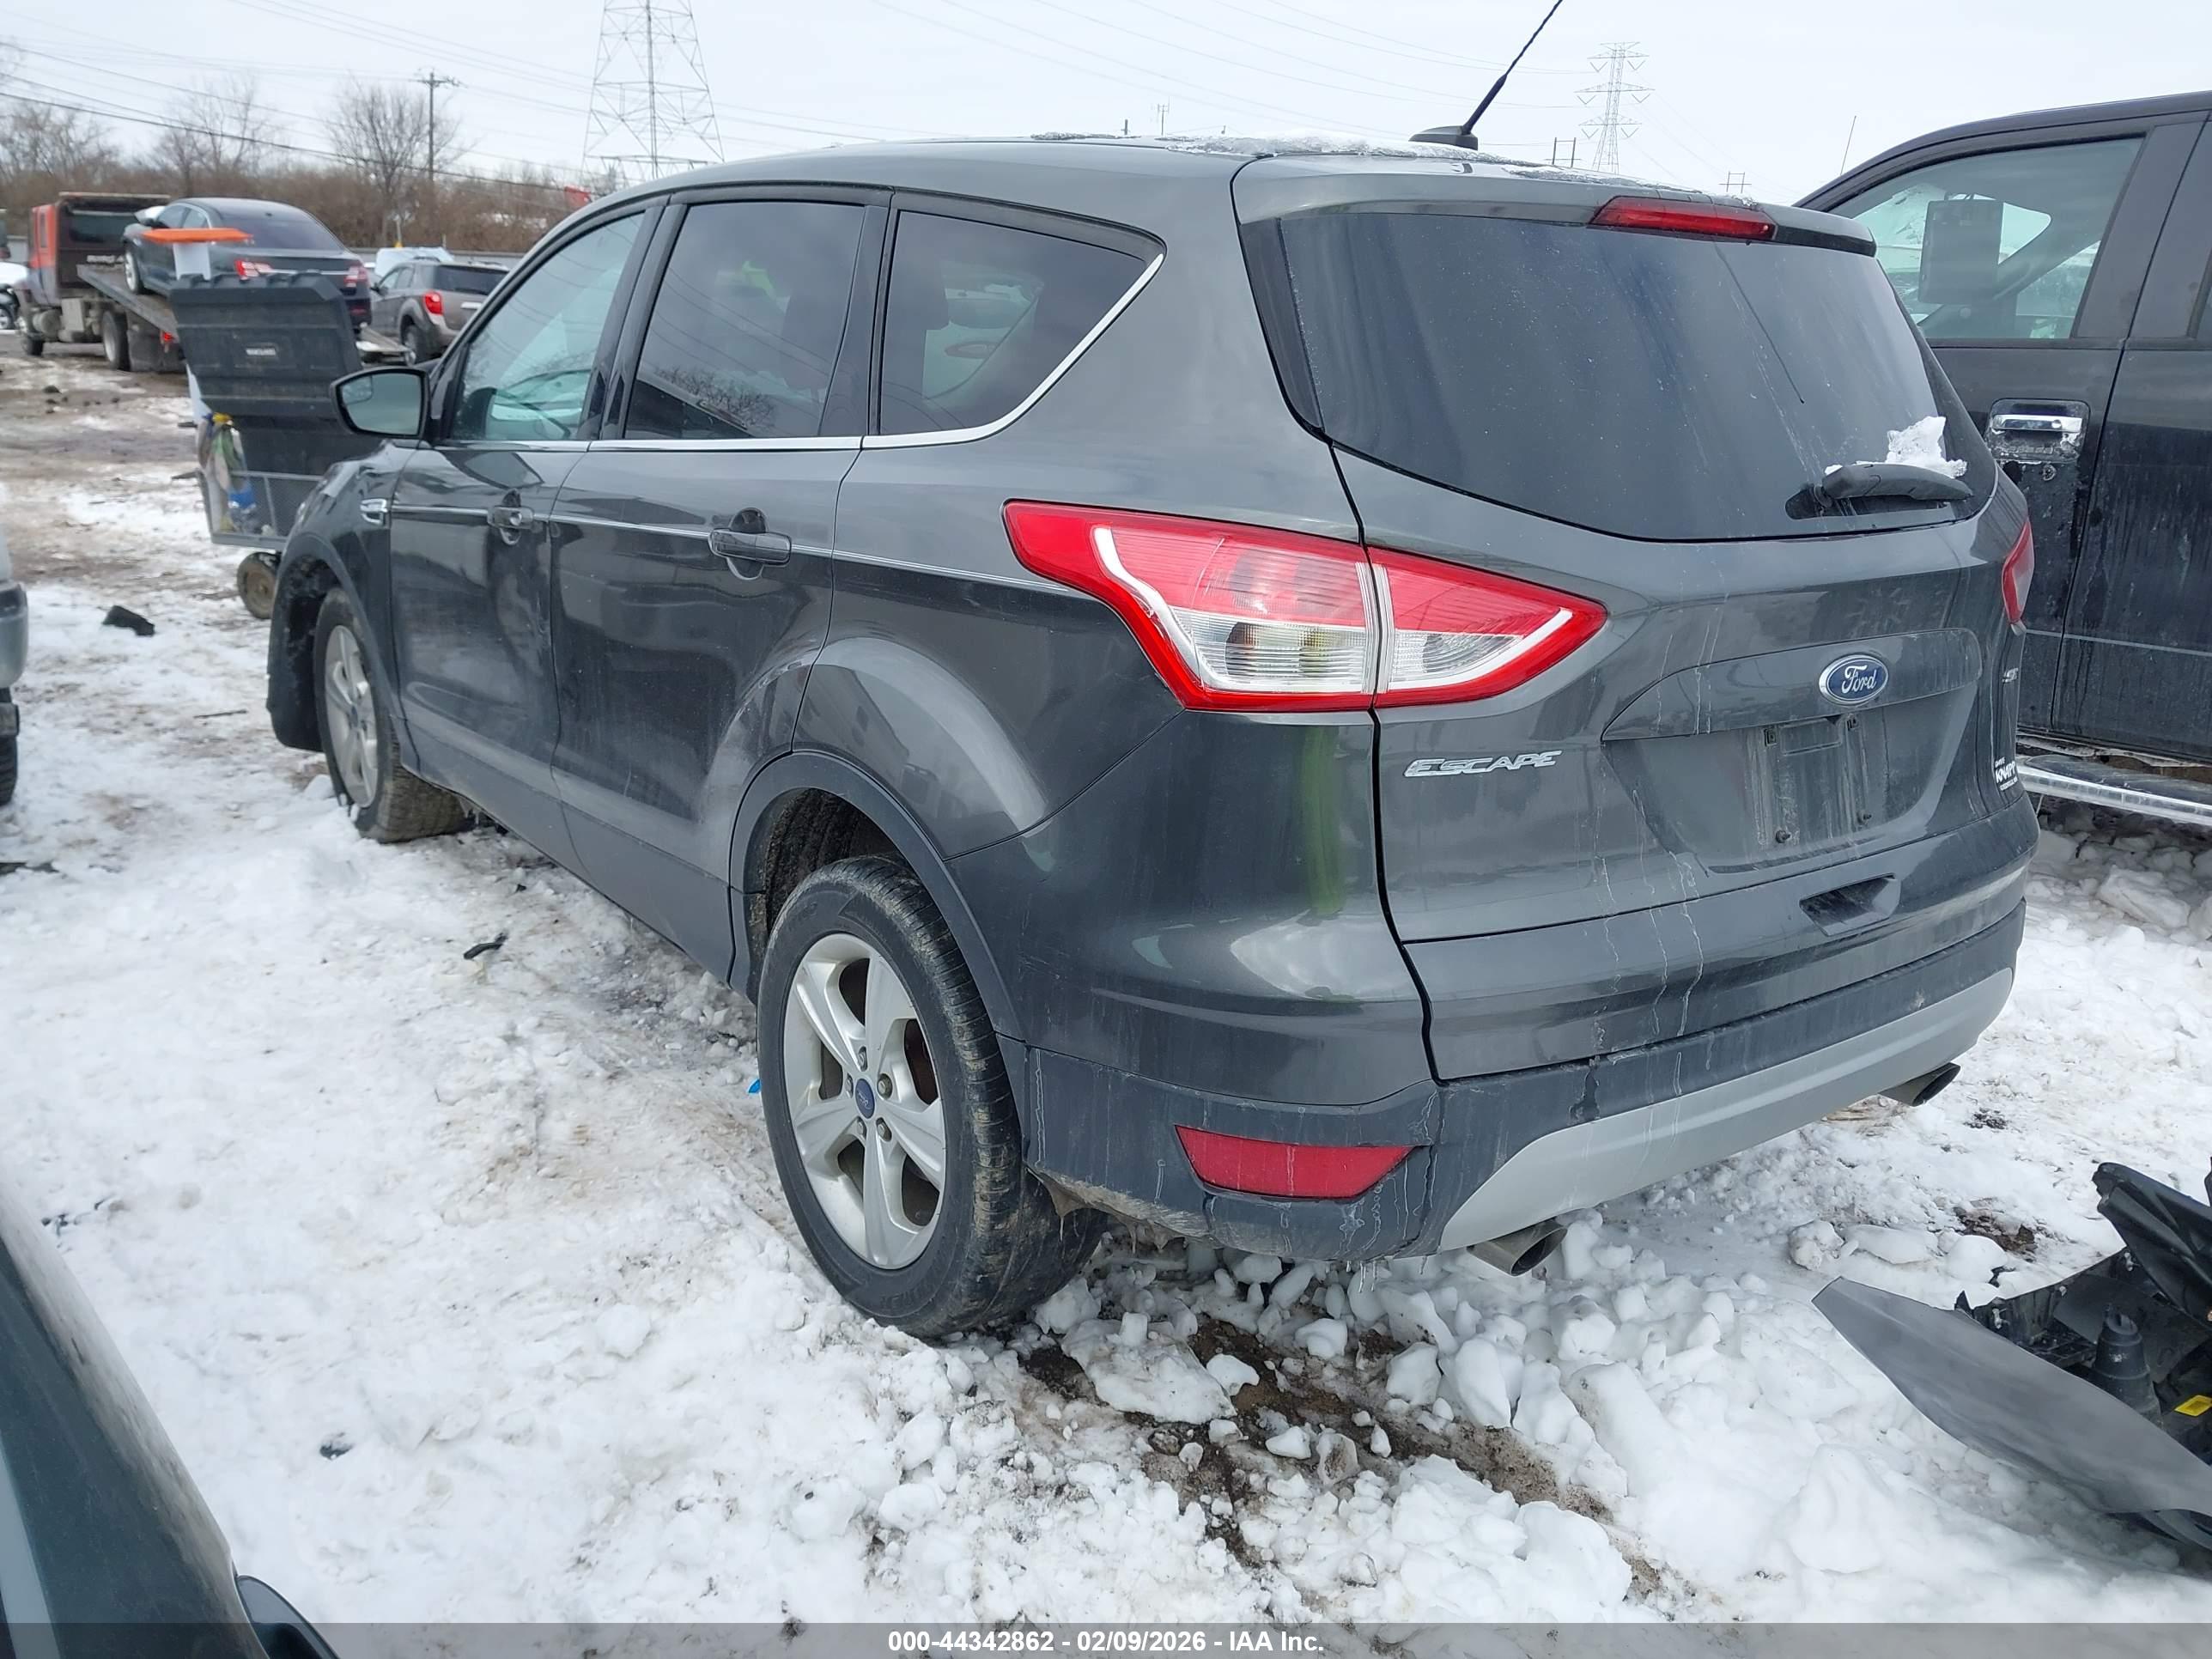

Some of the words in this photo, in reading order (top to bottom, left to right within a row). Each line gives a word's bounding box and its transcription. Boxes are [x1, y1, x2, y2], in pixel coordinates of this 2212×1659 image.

[1841, 665, 1878, 694] Ford
[1404, 749, 1564, 778] ESCAPE
[1996, 761, 2015, 784] KNAPP
